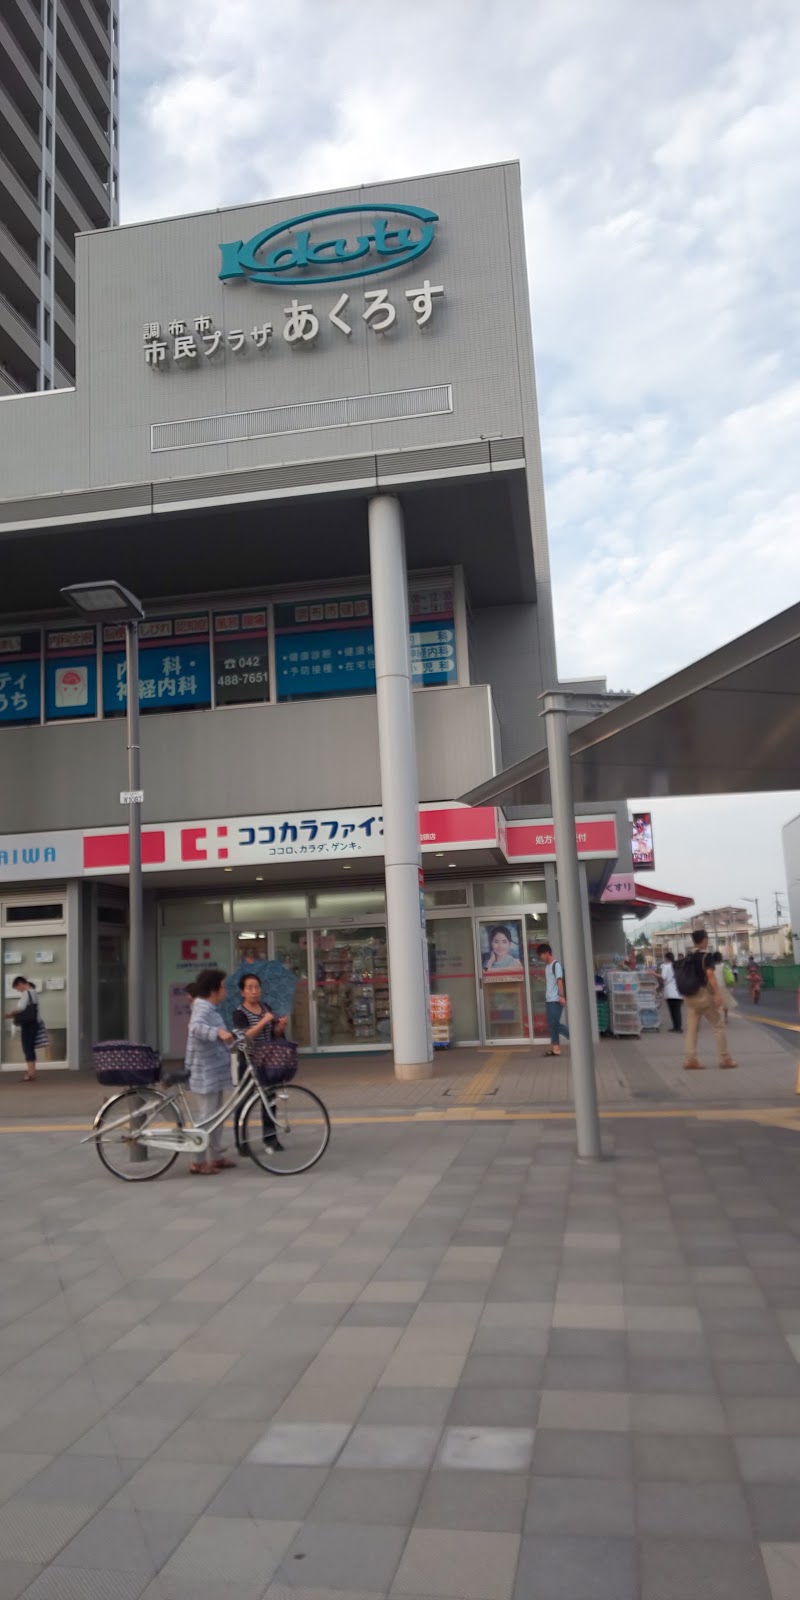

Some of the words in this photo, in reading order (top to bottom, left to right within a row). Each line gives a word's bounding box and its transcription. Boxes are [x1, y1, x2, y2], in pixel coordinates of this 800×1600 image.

[142, 314, 212, 340] 調布市
[143, 322, 273, 364] 市民プラザ
[282, 280, 445, 342] あくろす
[238, 656, 261, 669] 042
[217, 672, 268, 687] 488-7651
[238, 815, 385, 847] ココカラファイ
[268, 841, 362, 857] ココロ、カラダ、ゲンキ。
[605, 882, 631, 893] くすり
